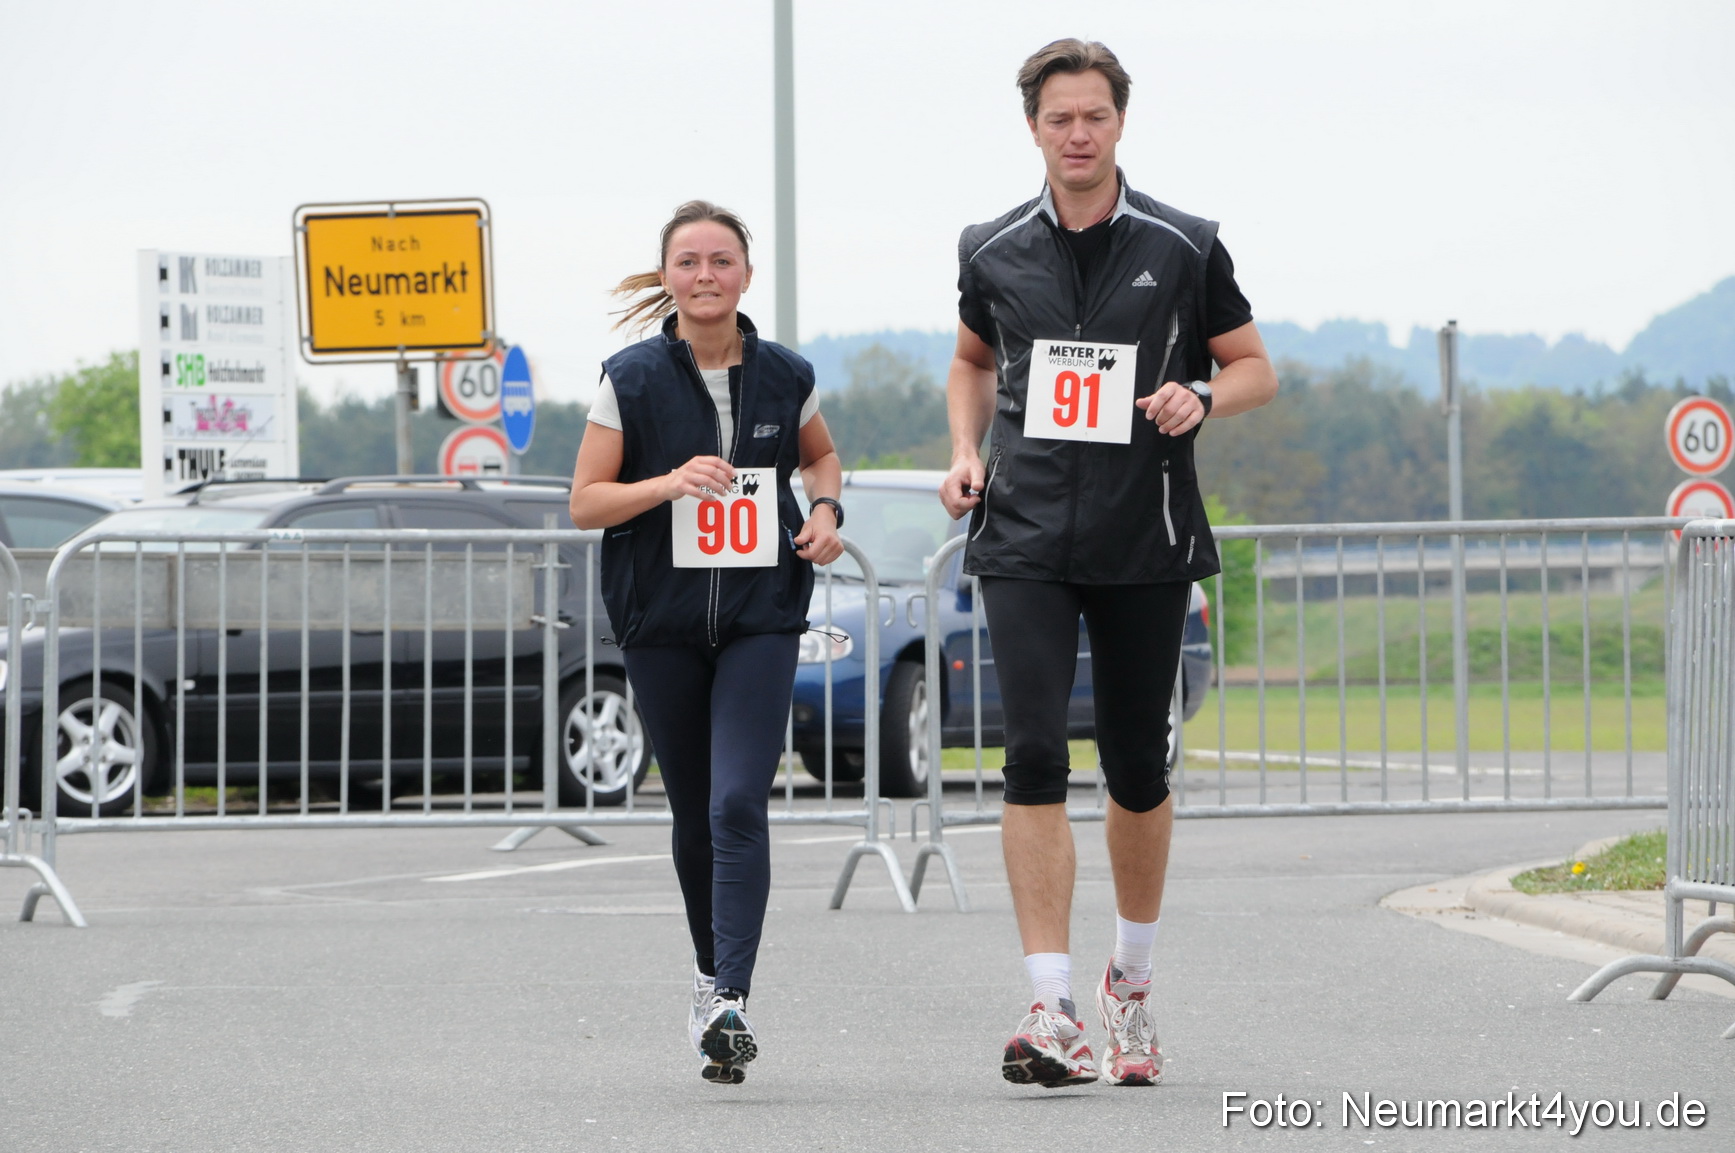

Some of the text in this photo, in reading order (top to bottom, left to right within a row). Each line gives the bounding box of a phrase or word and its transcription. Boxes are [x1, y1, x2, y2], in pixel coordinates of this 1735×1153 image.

[371, 235, 420, 252] Nach
[324, 261, 468, 298] Neumarkt
[1131, 279, 1157, 287] adidas
[374, 309, 425, 327] 5 km
[1048, 345, 1094, 359] MEYER
[1048, 356, 1095, 368] WERBUNG
[460, 364, 497, 398] 60
[1052, 370, 1101, 428] 91
[1684, 420, 1719, 453] 60
[697, 498, 758, 555] 90
